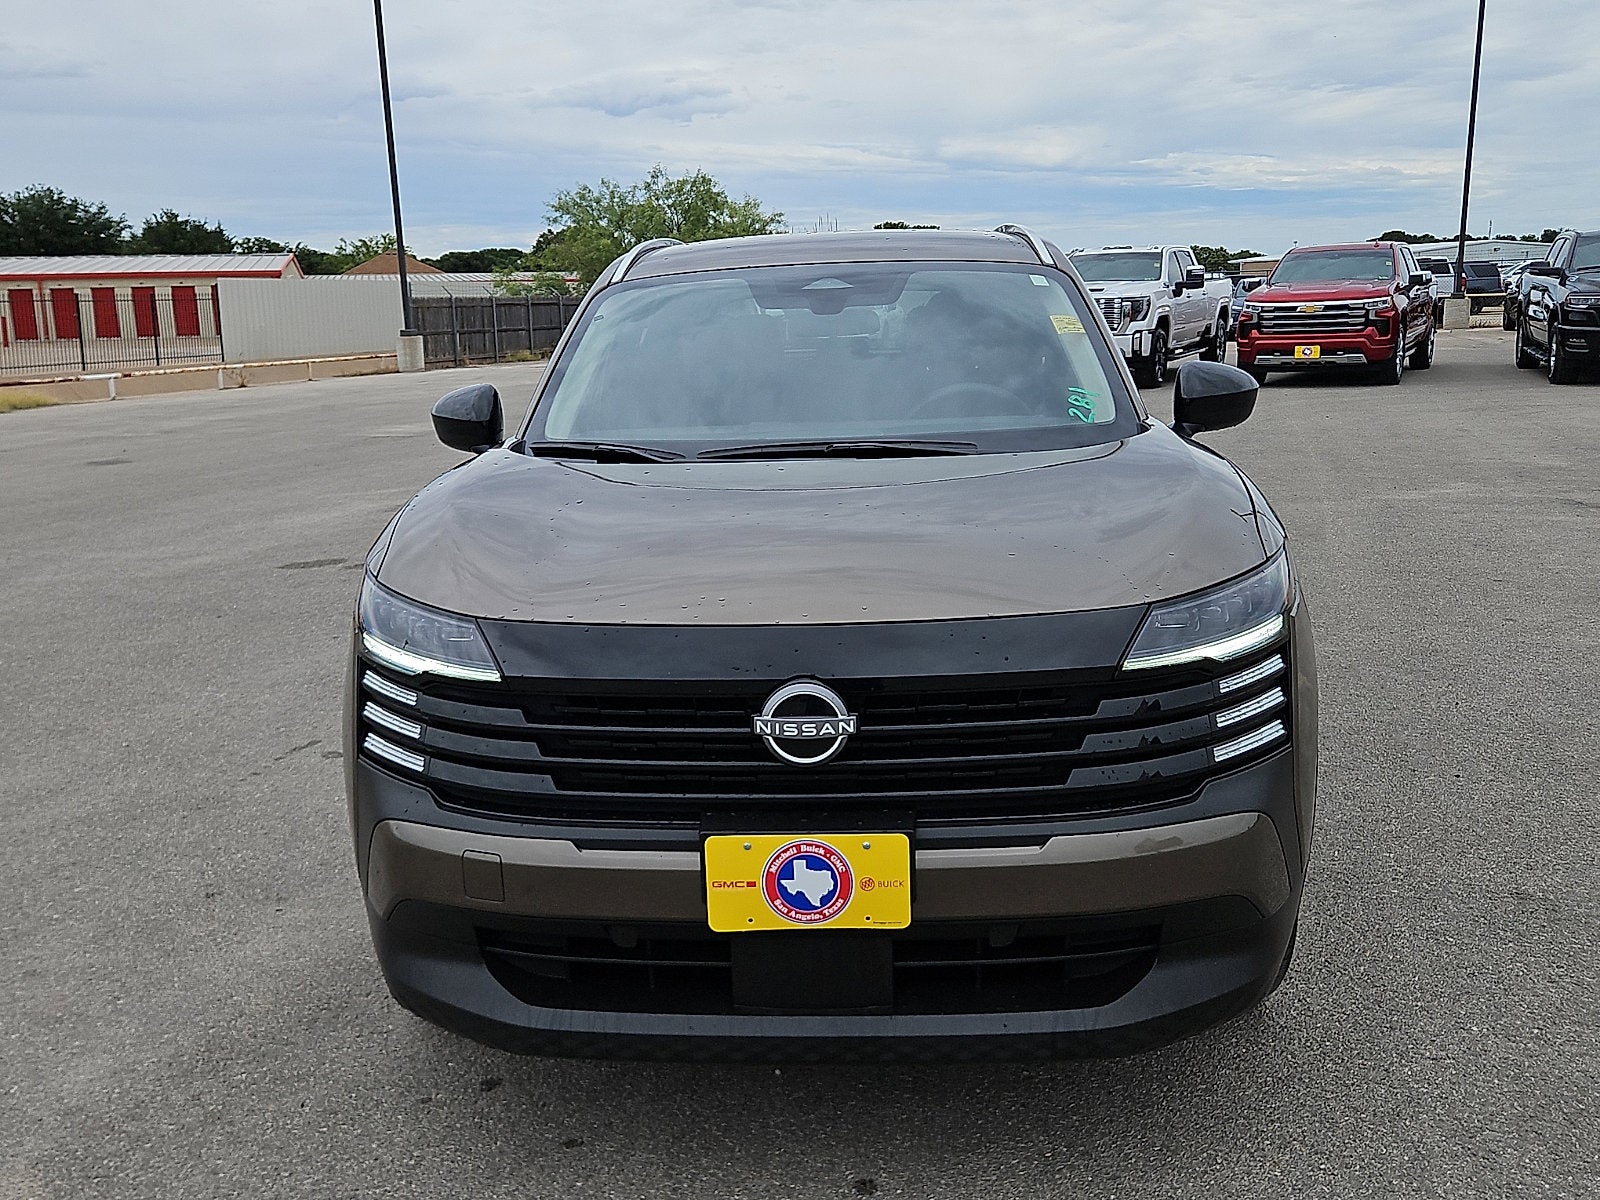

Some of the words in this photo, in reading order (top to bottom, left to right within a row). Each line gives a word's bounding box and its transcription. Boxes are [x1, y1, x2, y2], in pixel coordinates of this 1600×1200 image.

[1068, 386, 1100, 424] 281
[756, 720, 854, 736] NISSAN
[769, 846, 798, 874] Mitchell
[800, 844, 826, 856] Buick
[830, 854, 847, 873] GMC
[712, 880, 746, 889] GMC
[877, 880, 905, 888] BUICK
[773, 898, 789, 914] San
[788, 911, 824, 921] Angelo,
[822, 897, 846, 917] Texas
